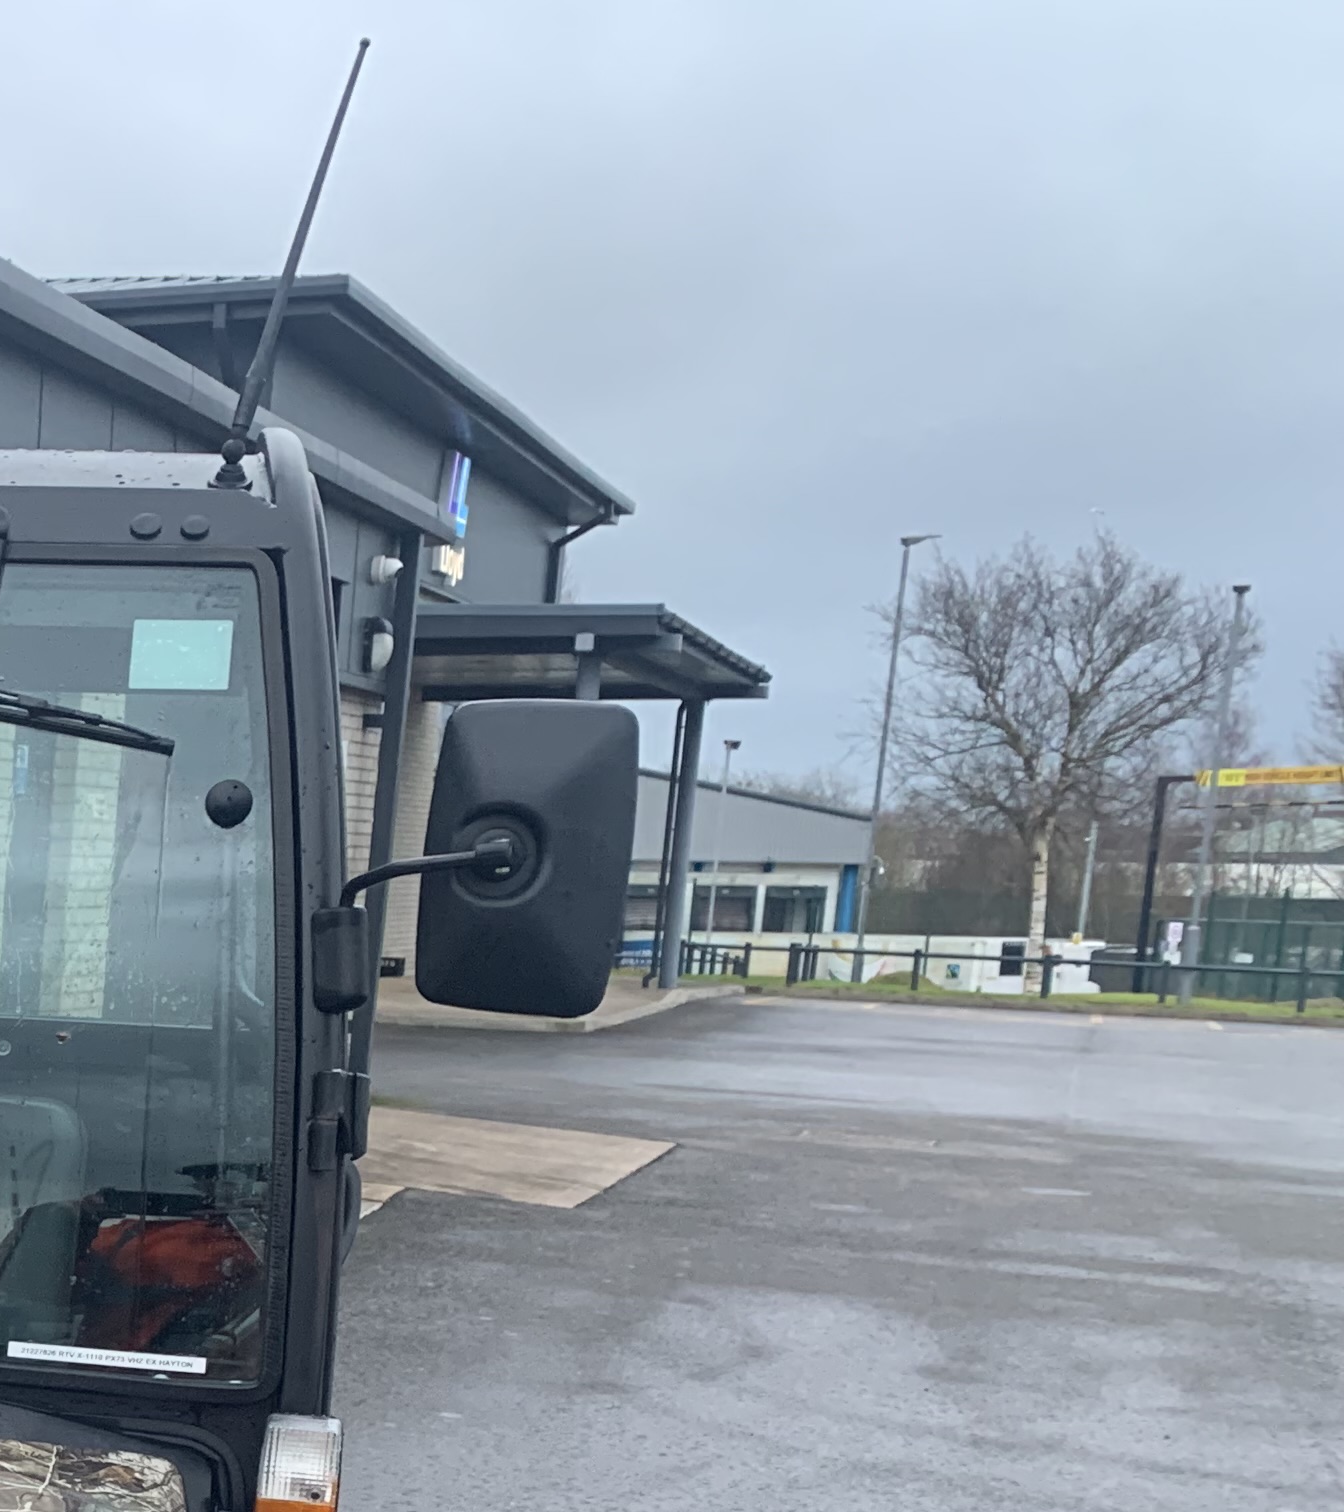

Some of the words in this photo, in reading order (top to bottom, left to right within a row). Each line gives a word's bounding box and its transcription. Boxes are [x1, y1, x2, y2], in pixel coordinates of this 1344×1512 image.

[58, 1350, 75, 1358] RTV
[145, 1358, 157, 1366] EX
[158, 1359, 193, 1368] HAYTON
